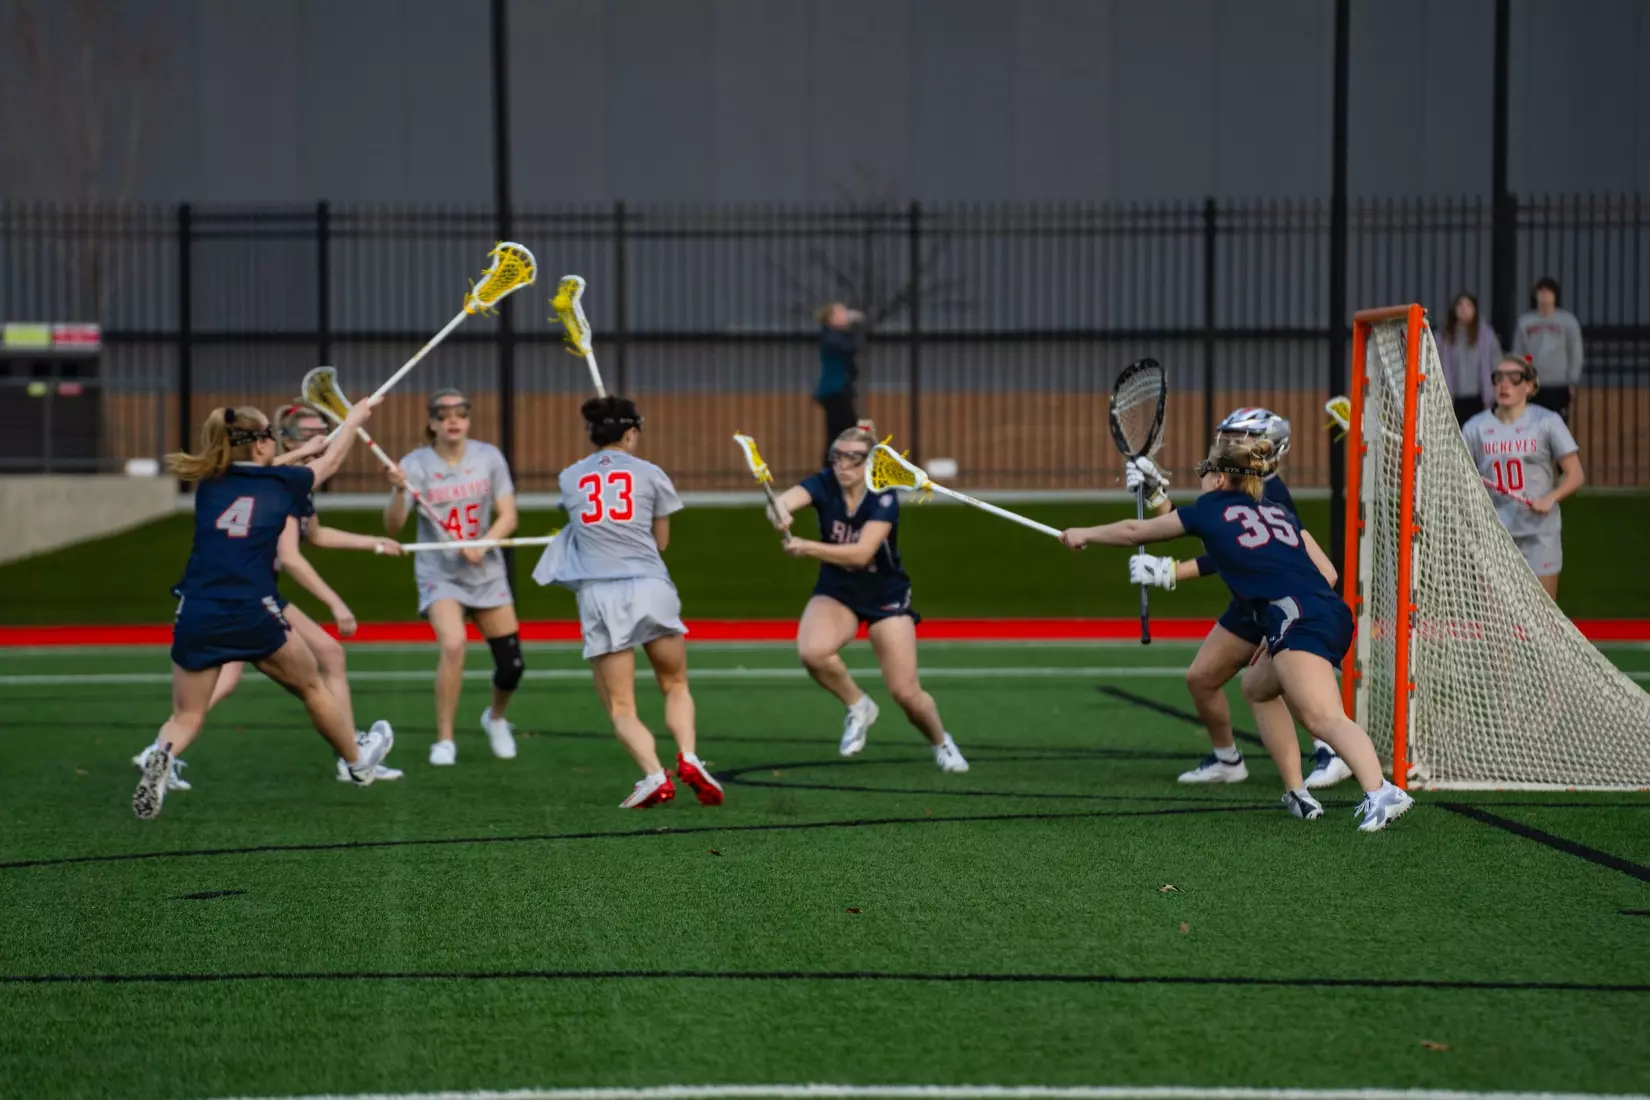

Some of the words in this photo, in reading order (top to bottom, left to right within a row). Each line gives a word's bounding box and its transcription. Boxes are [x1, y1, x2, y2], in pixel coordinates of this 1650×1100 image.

[1493, 458, 1524, 494] 10
[215, 496, 255, 538] 4
[578, 470, 634, 525] 33
[445, 504, 480, 540] 45
[1223, 505, 1300, 549] 35
